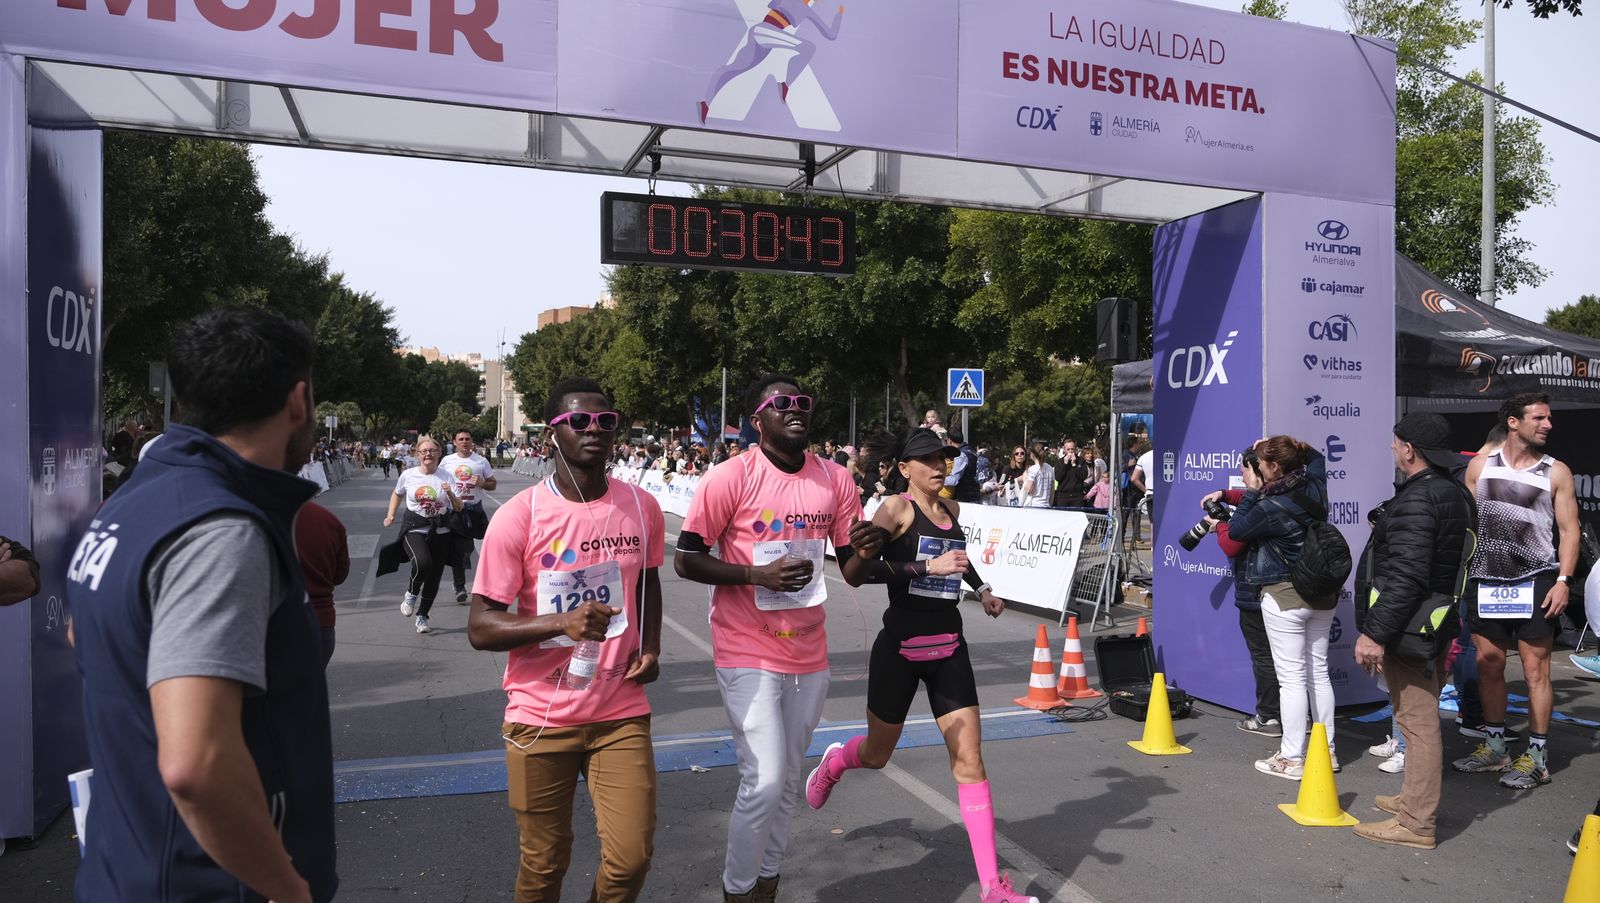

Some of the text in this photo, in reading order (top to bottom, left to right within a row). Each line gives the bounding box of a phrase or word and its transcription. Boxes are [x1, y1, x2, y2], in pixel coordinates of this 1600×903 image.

[1050, 12, 1226, 65] LA IGUALDAD
[1003, 51, 1265, 115] ES NUESTRA META.
[1016, 105, 1062, 131] CDX
[1112, 116, 1161, 133] ALMERÍA
[1111, 128, 1138, 139] CIUDAD
[648, 203, 844, 267] 00:30:43
[1305, 241, 1361, 256] HYUNDAI
[1312, 255, 1355, 267] Almerialva
[1320, 281, 1364, 295] cajamar
[47, 285, 95, 354] CDX
[1309, 318, 1348, 342] CASI
[1168, 338, 1234, 389] CDX
[1321, 357, 1362, 371] vithas
[1497, 351, 1600, 378] cruzandolam
[1313, 402, 1360, 420] aqualia
[1184, 450, 1243, 469] ALMERÍA
[1184, 470, 1214, 481] CIUDAD
[1333, 501, 1359, 524] CASH
[581, 532, 640, 552] convive
[1008, 531, 1073, 556] ALMERÍA
[1007, 552, 1039, 568] CIUDAD
[1490, 588, 1520, 599] 408
